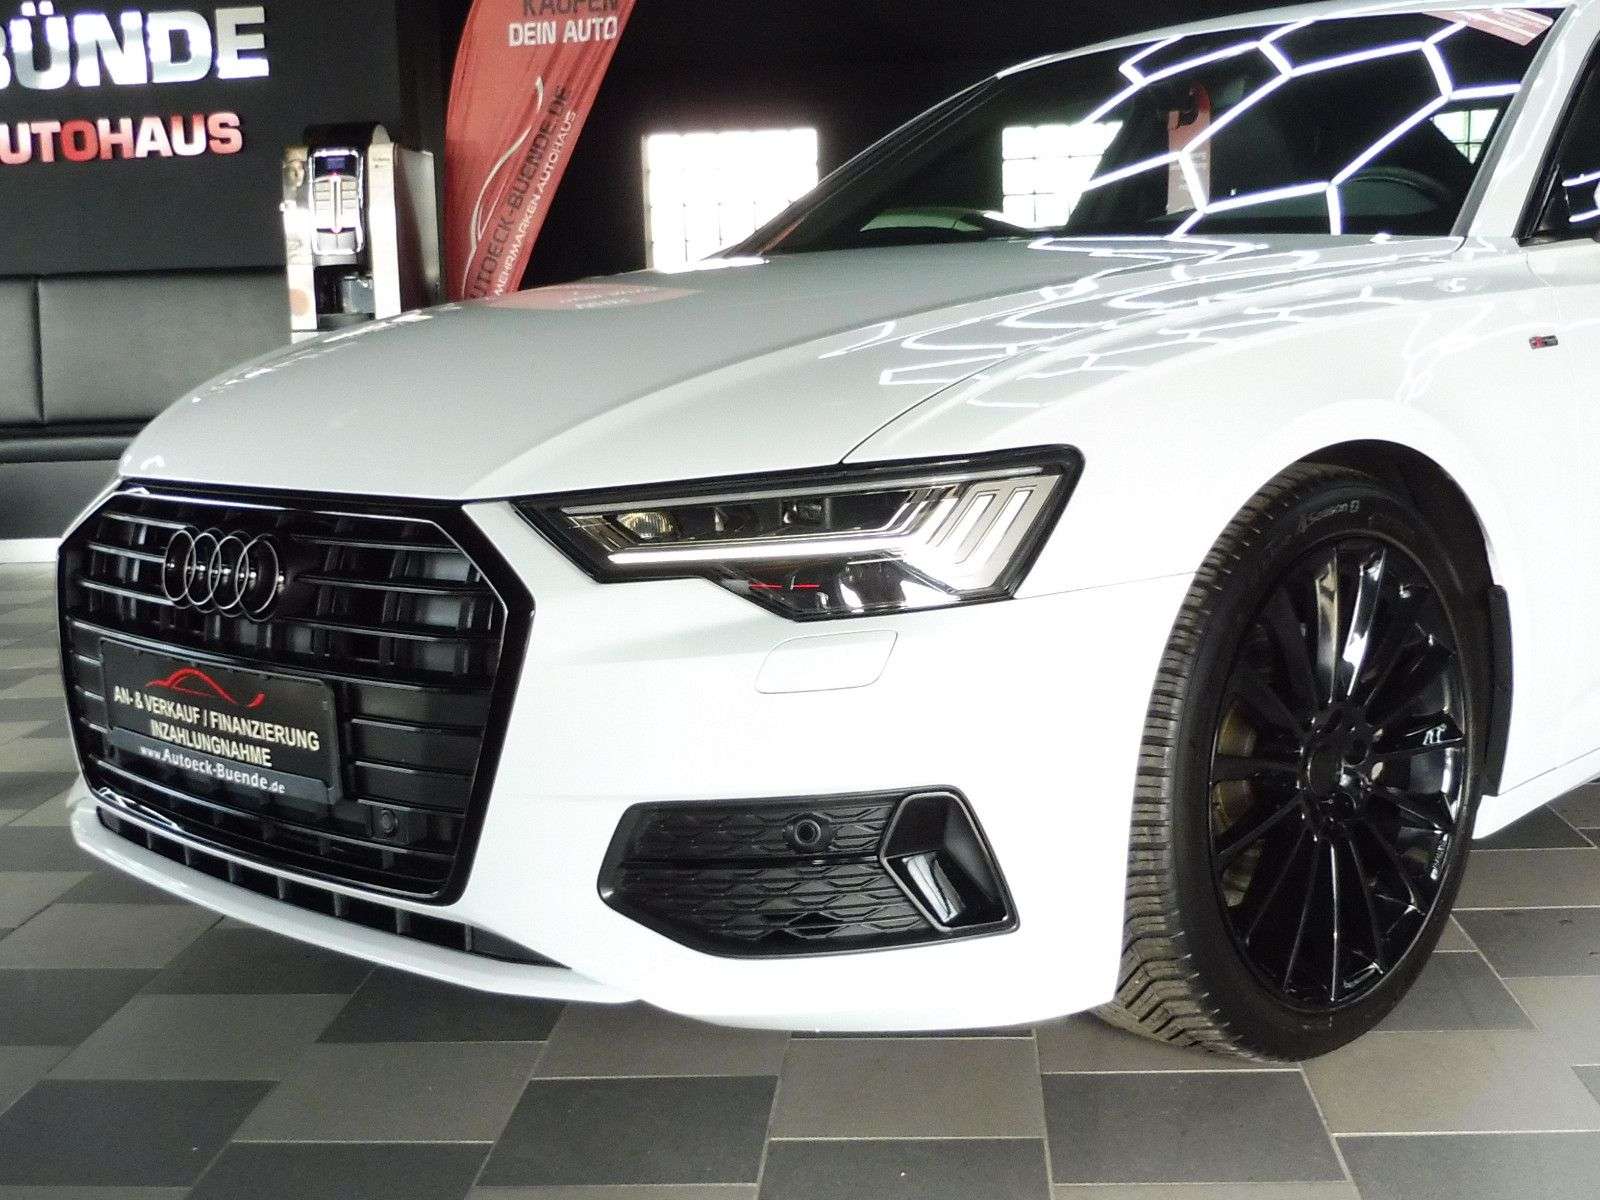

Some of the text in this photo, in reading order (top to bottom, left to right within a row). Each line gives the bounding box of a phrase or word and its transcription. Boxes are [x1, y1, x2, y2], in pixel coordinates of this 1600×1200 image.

[0, 1, 269, 90] ÜNDE
[509, 15, 618, 47] DEIN AUTO
[536, 109, 577, 193] AUTOHAUS
[143, 693, 200, 724] VERKAUF
[209, 710, 320, 752] FINANZIERUNG
[150, 719, 272, 768] INZAHLUNGNAHME
[139, 745, 286, 794] www.Autoeck-Buende.de
